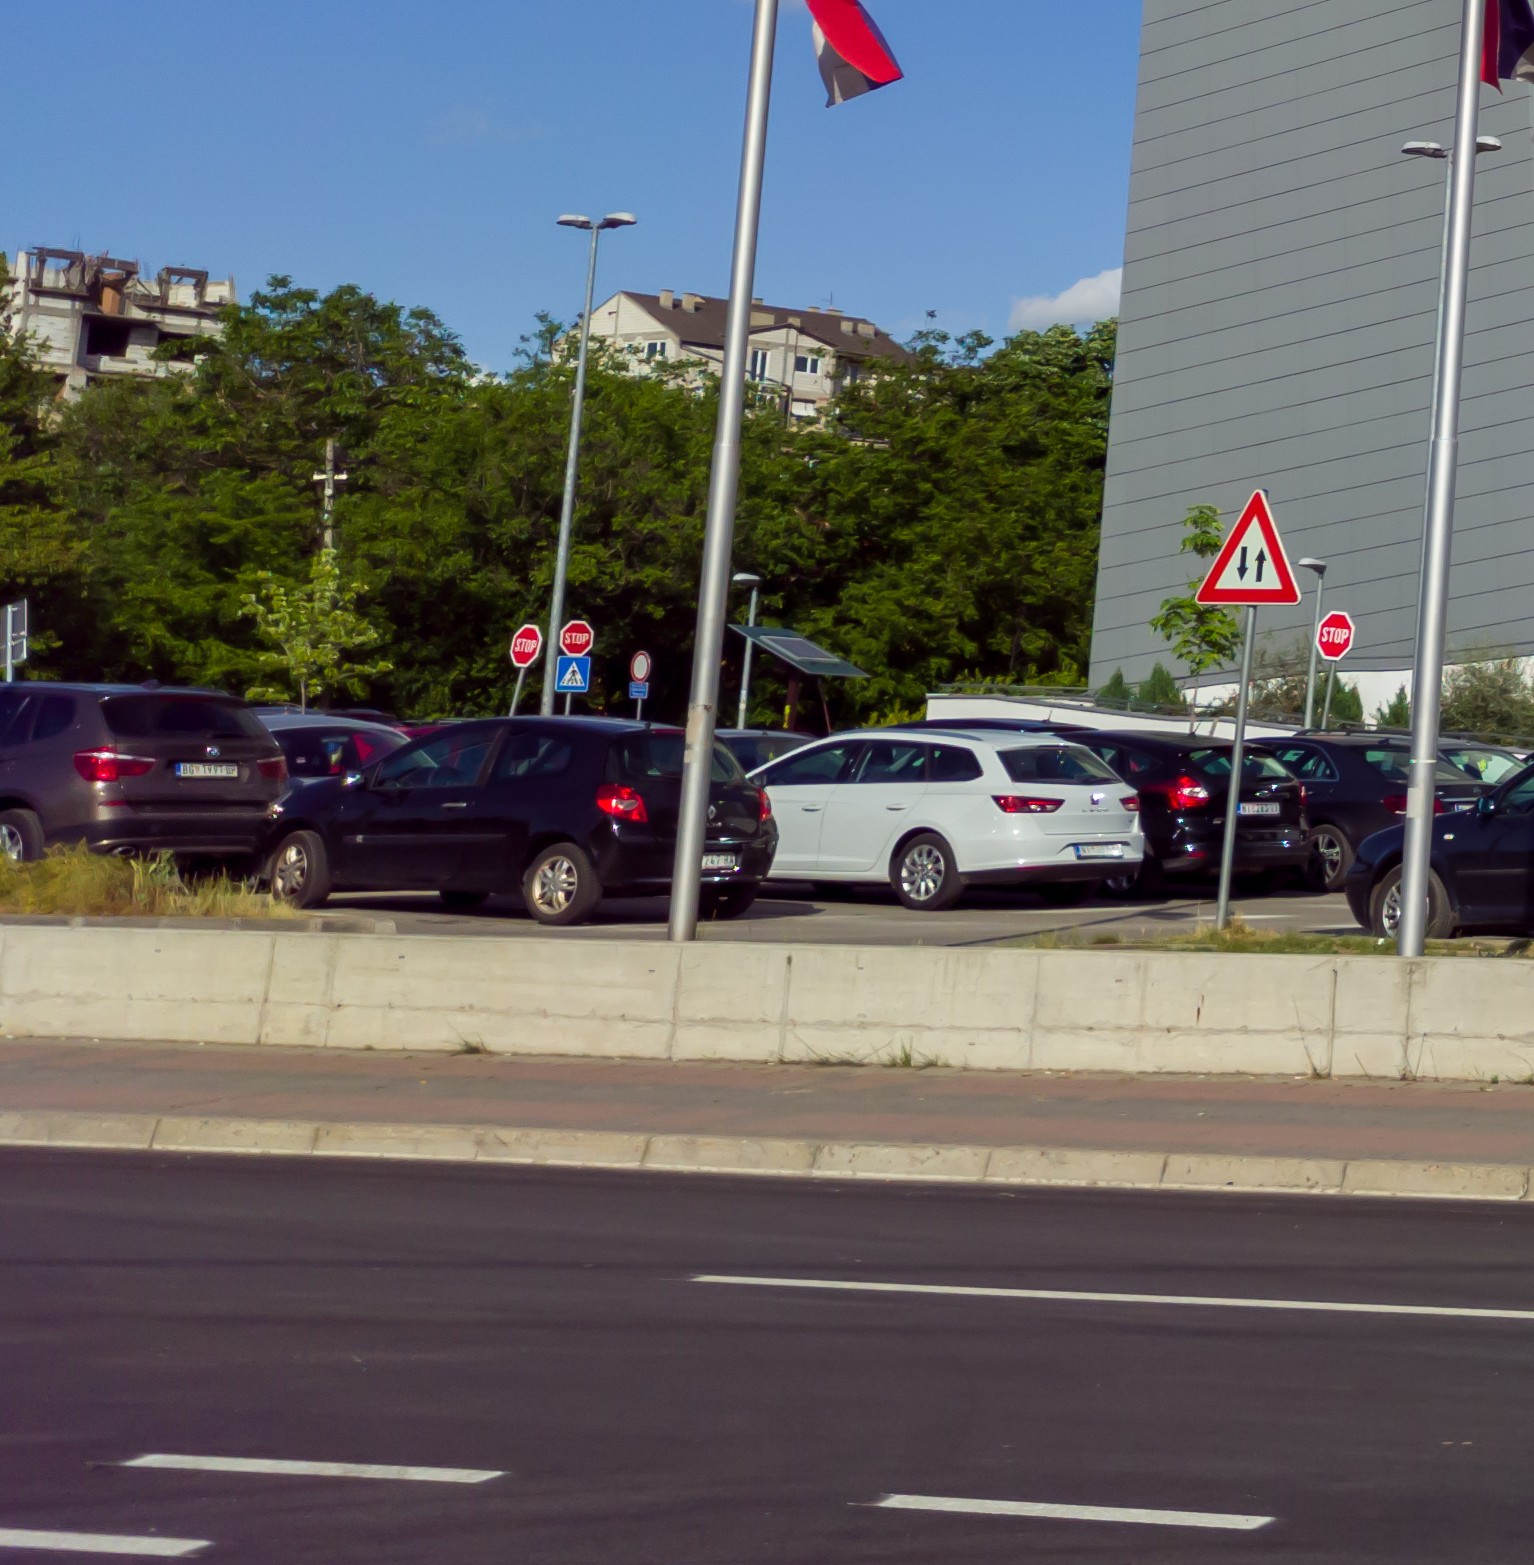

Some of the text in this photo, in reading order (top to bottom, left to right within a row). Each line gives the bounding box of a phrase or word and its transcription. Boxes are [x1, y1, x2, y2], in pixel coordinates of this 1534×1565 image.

[565, 632, 589, 644] STOP
[1321, 627, 1349, 644] STOP
[514, 638, 537, 652] STOP
